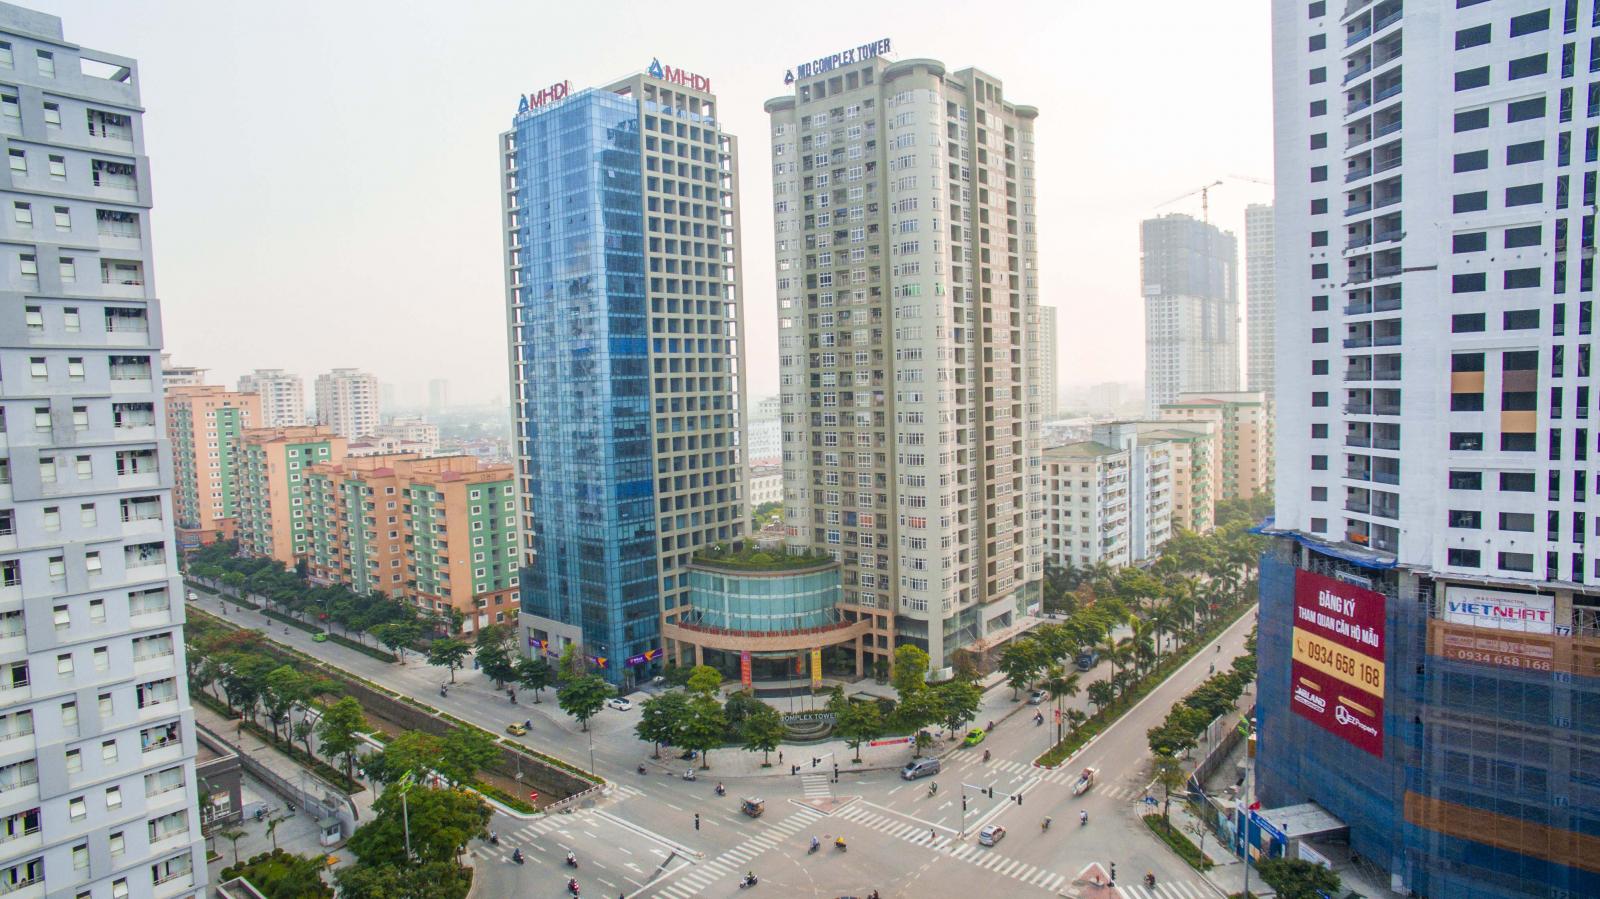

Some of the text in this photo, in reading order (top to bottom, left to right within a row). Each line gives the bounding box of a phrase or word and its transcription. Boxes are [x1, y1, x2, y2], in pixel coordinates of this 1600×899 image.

[797, 37, 891, 80] MD COMPLEX TOWER
[530, 79, 568, 110] MHDI
[665, 64, 711, 94] MHDI
[1319, 590, 1356, 618] ĐĂNG KÝ
[1298, 606, 1316, 623] THAM
[1317, 613, 1335, 631] QUAN
[1350, 624, 1361, 643] HỘ
[1308, 641, 1379, 687] 0934 658 168
[1457, 650, 1550, 672] 0934 658 168
